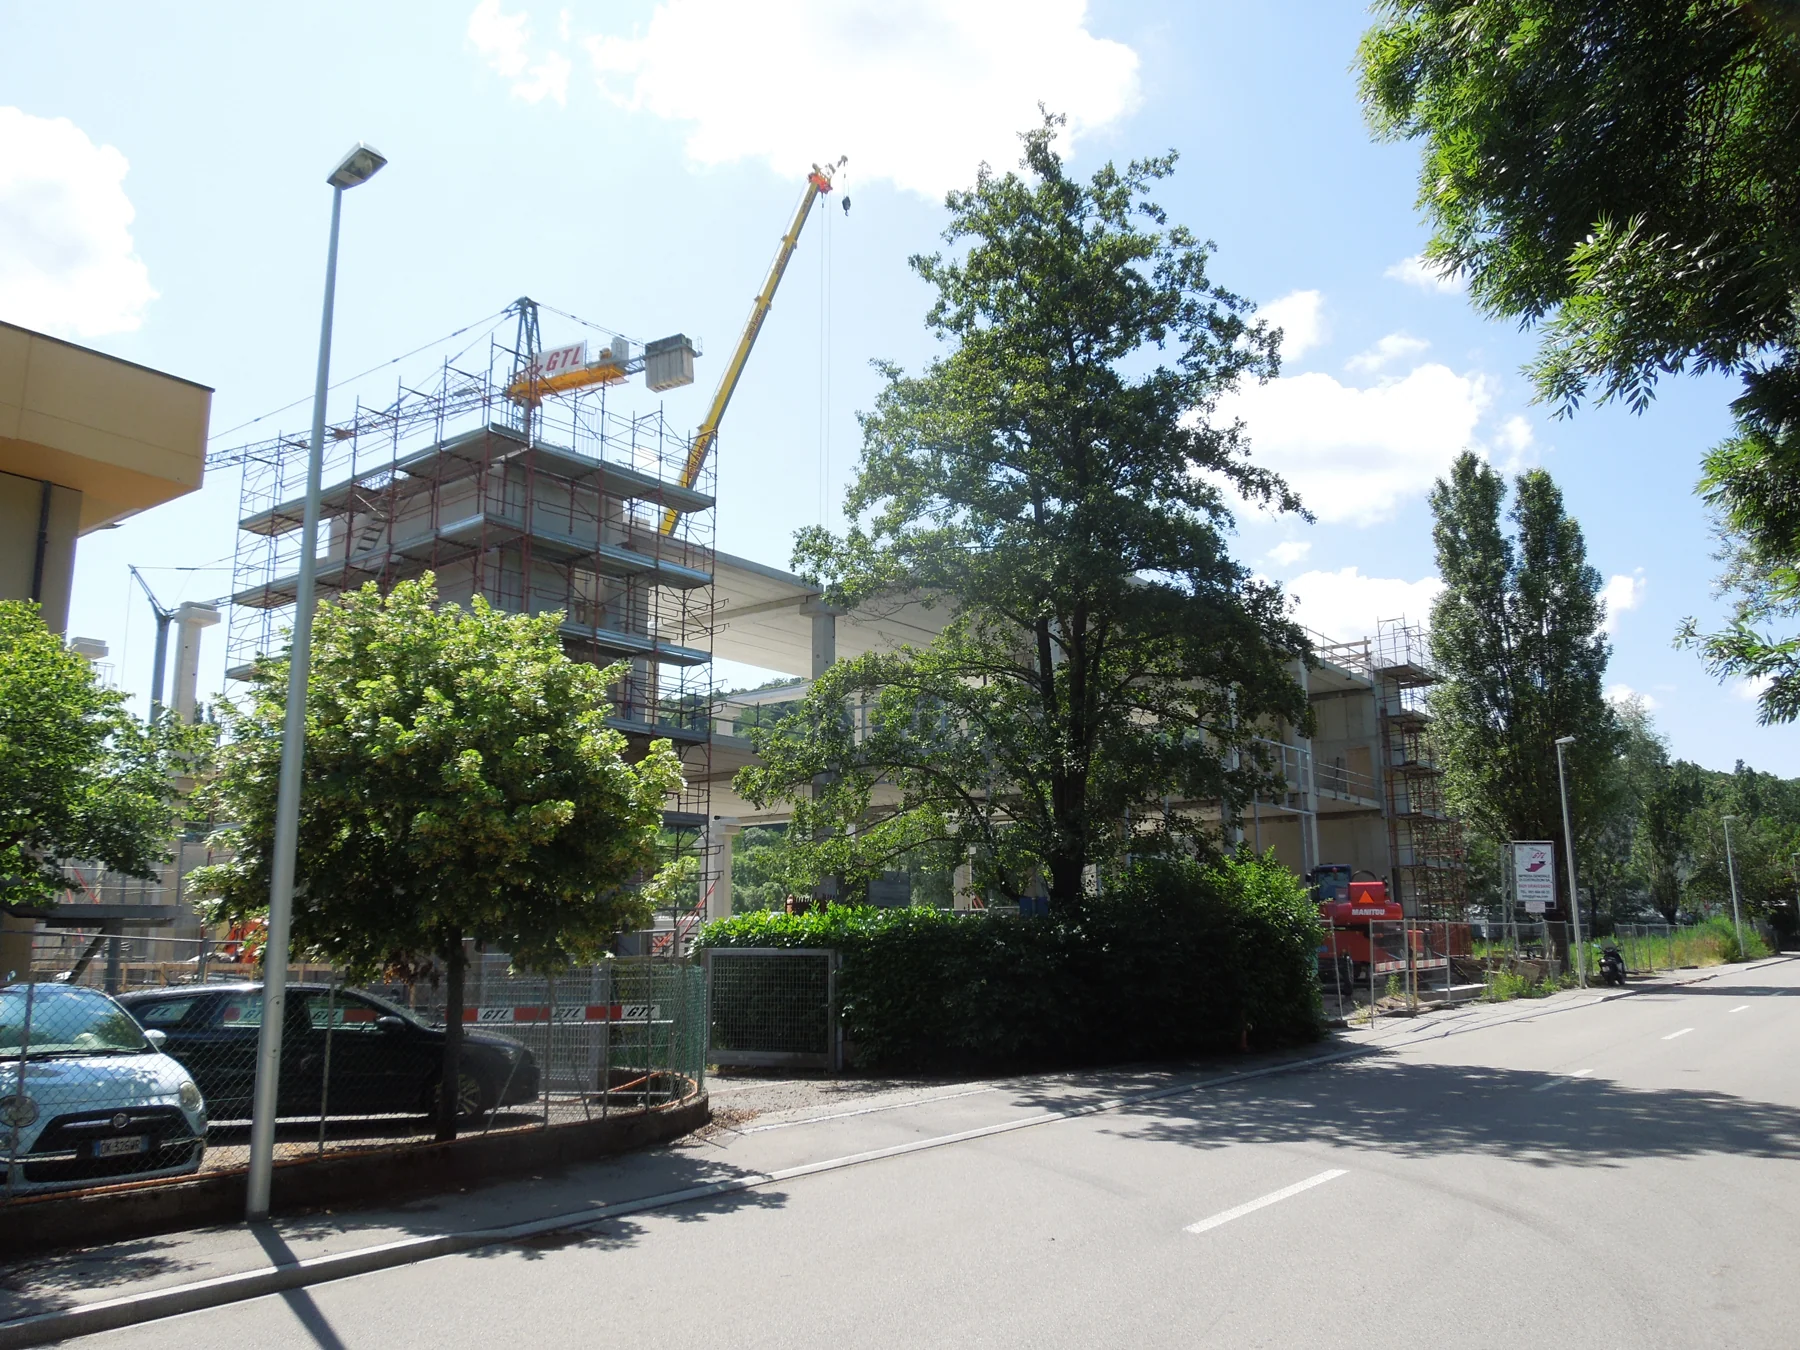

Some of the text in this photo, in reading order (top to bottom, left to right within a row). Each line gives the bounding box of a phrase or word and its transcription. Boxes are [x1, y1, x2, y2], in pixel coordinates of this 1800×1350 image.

[545, 347, 580, 372] GTL
[1352, 908, 1385, 916] MANITOU
[482, 1008, 509, 1020] GTL
[553, 1008, 580, 1019] GTL
